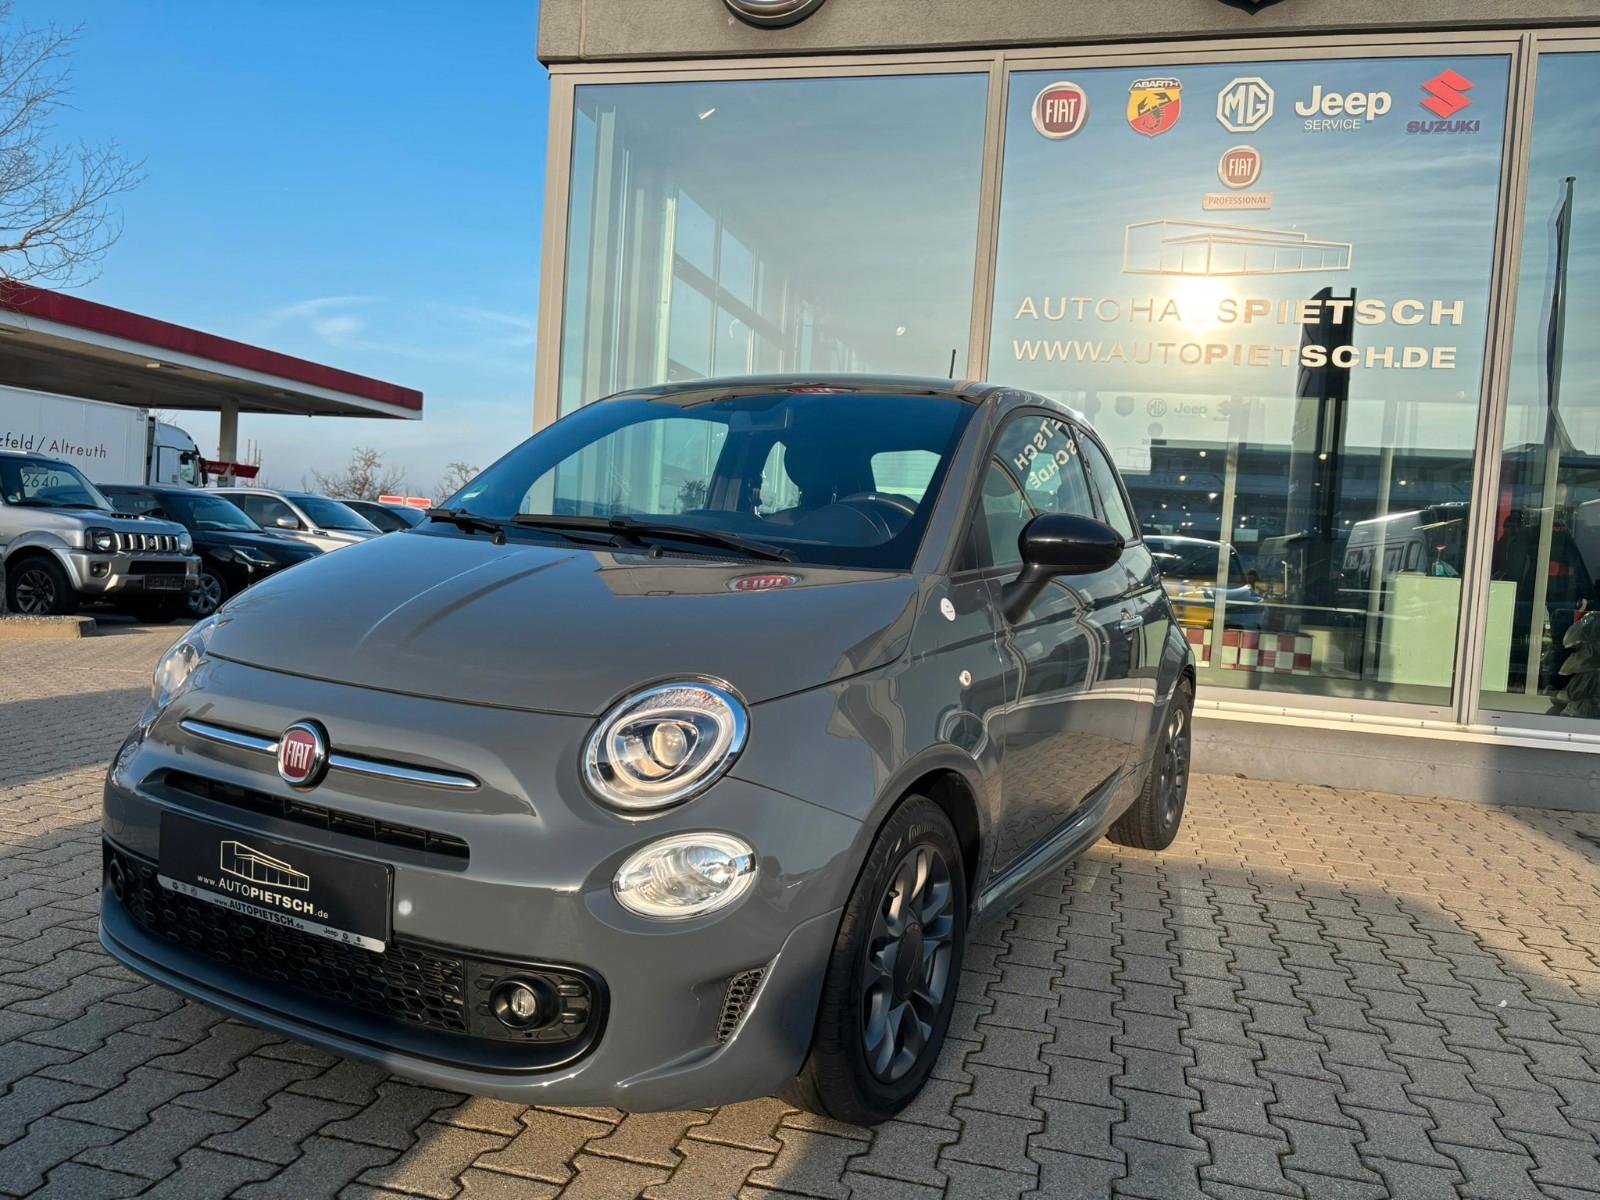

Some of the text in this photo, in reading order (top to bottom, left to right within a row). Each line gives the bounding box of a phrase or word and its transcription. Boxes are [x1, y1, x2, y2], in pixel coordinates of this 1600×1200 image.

[1134, 80, 1178, 89] ABARTH
[1045, 98, 1077, 123] FIAT
[1223, 84, 1267, 125] MG
[1295, 85, 1392, 121] Jeep
[1304, 119, 1361, 131] SERVICE
[1406, 119, 1480, 134] SUZUKI
[1229, 158, 1254, 177] FIAT
[1207, 195, 1268, 206] PROFESSIONAL
[1012, 338, 1457, 369] WWW.AUTOPIETSCH.DE
[49, 438, 107, 458] Altreuth
[22, 473, 59, 488] 2640
[284, 740, 313, 770] FIAT
[197, 874, 329, 919] www.AUTOPIETSCH.de
